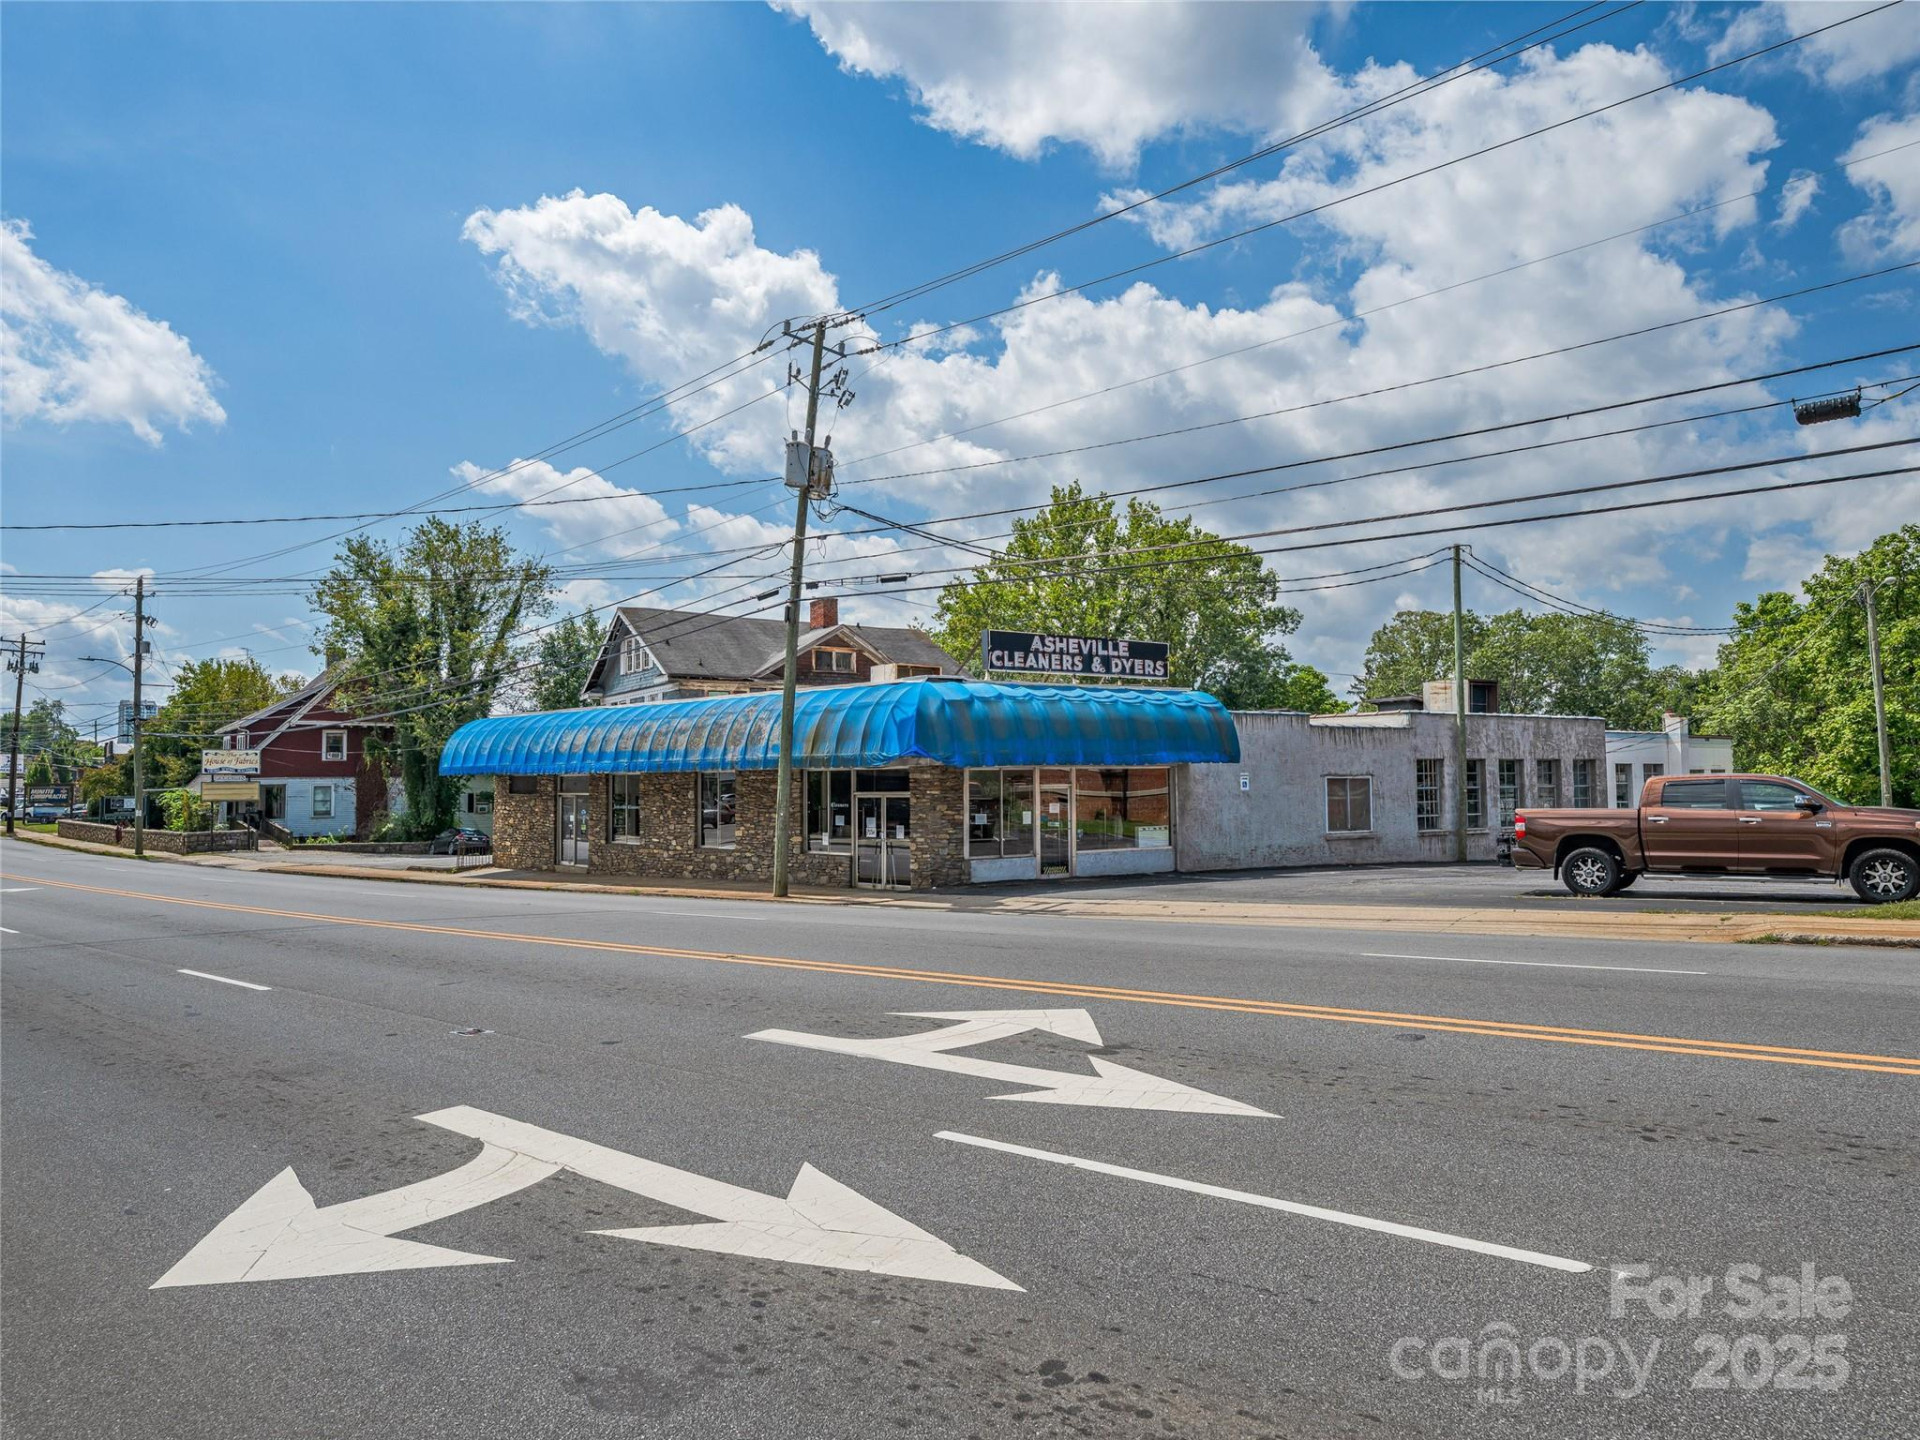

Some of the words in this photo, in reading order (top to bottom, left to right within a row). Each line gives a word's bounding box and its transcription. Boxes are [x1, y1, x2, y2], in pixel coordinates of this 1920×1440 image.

[1030, 635, 1130, 657] ASHEVILLE
[991, 650, 1083, 672] CLEANERS
[1091, 656, 1106, 673] &
[1111, 658, 1165, 676] DYERS
[204, 757, 226, 766] House
[227, 758, 233, 766] of
[234, 757, 258, 766] Fabrics
